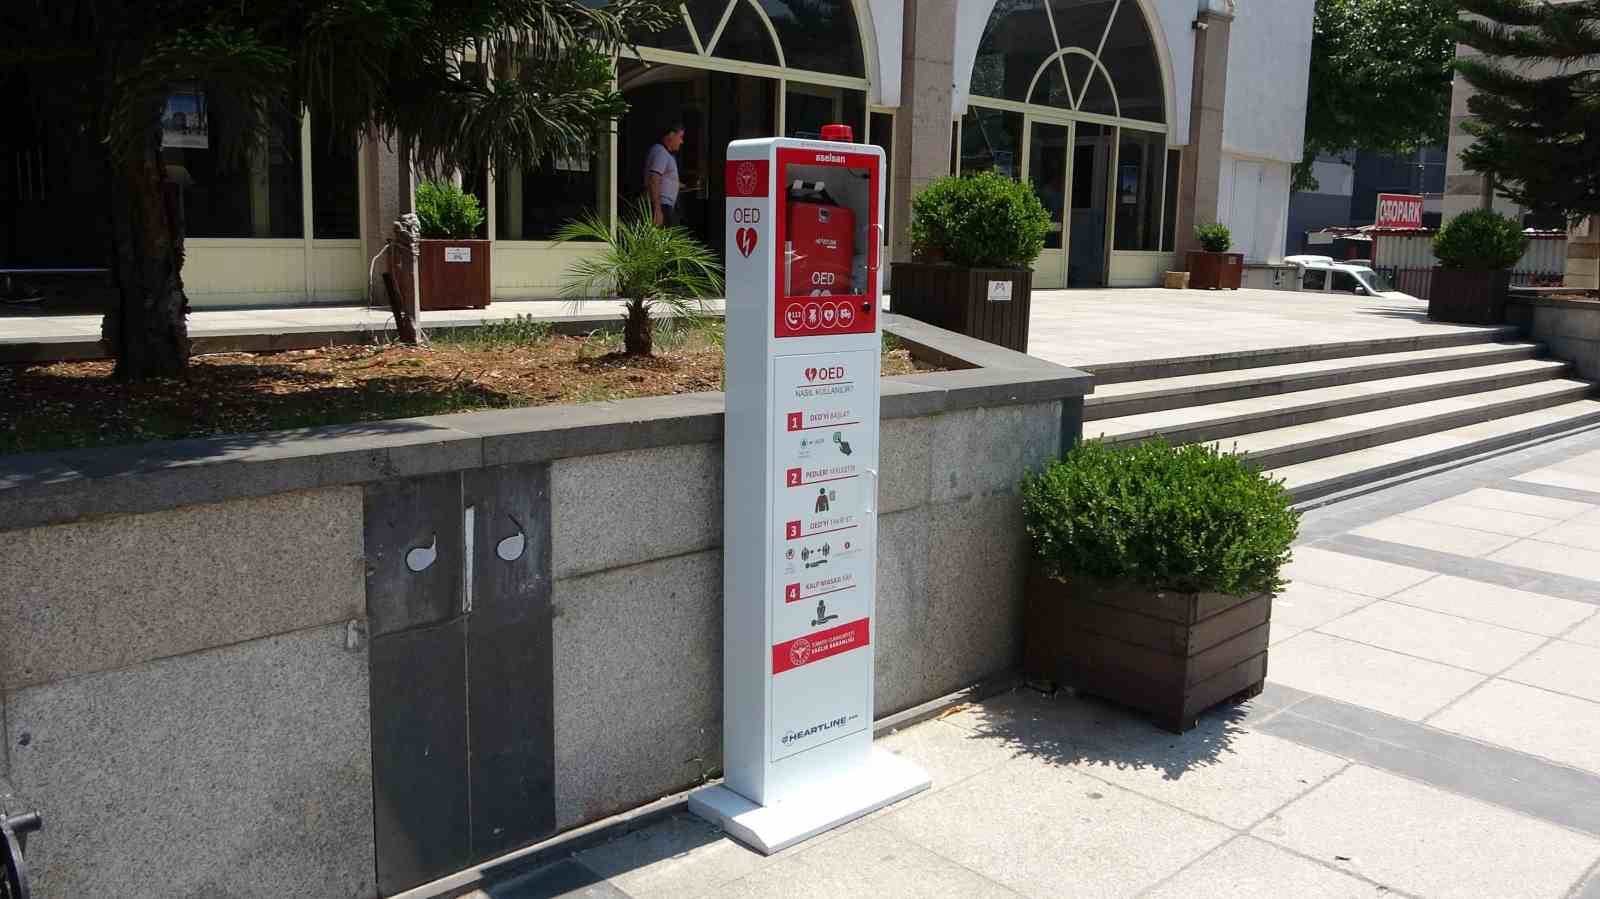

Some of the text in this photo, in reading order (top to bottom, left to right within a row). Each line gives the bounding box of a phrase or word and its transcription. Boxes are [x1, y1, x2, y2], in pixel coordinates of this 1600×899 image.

[734, 208, 760, 223] OED
[1380, 200, 1421, 222] OTOPARK
[812, 272, 835, 284] OED
[819, 367, 844, 380] OED
[792, 417, 798, 428] 1
[792, 473, 797, 484] 2
[790, 526, 797, 537] 3
[790, 588, 796, 599] 4
[788, 716, 847, 742] HEARTLINE
